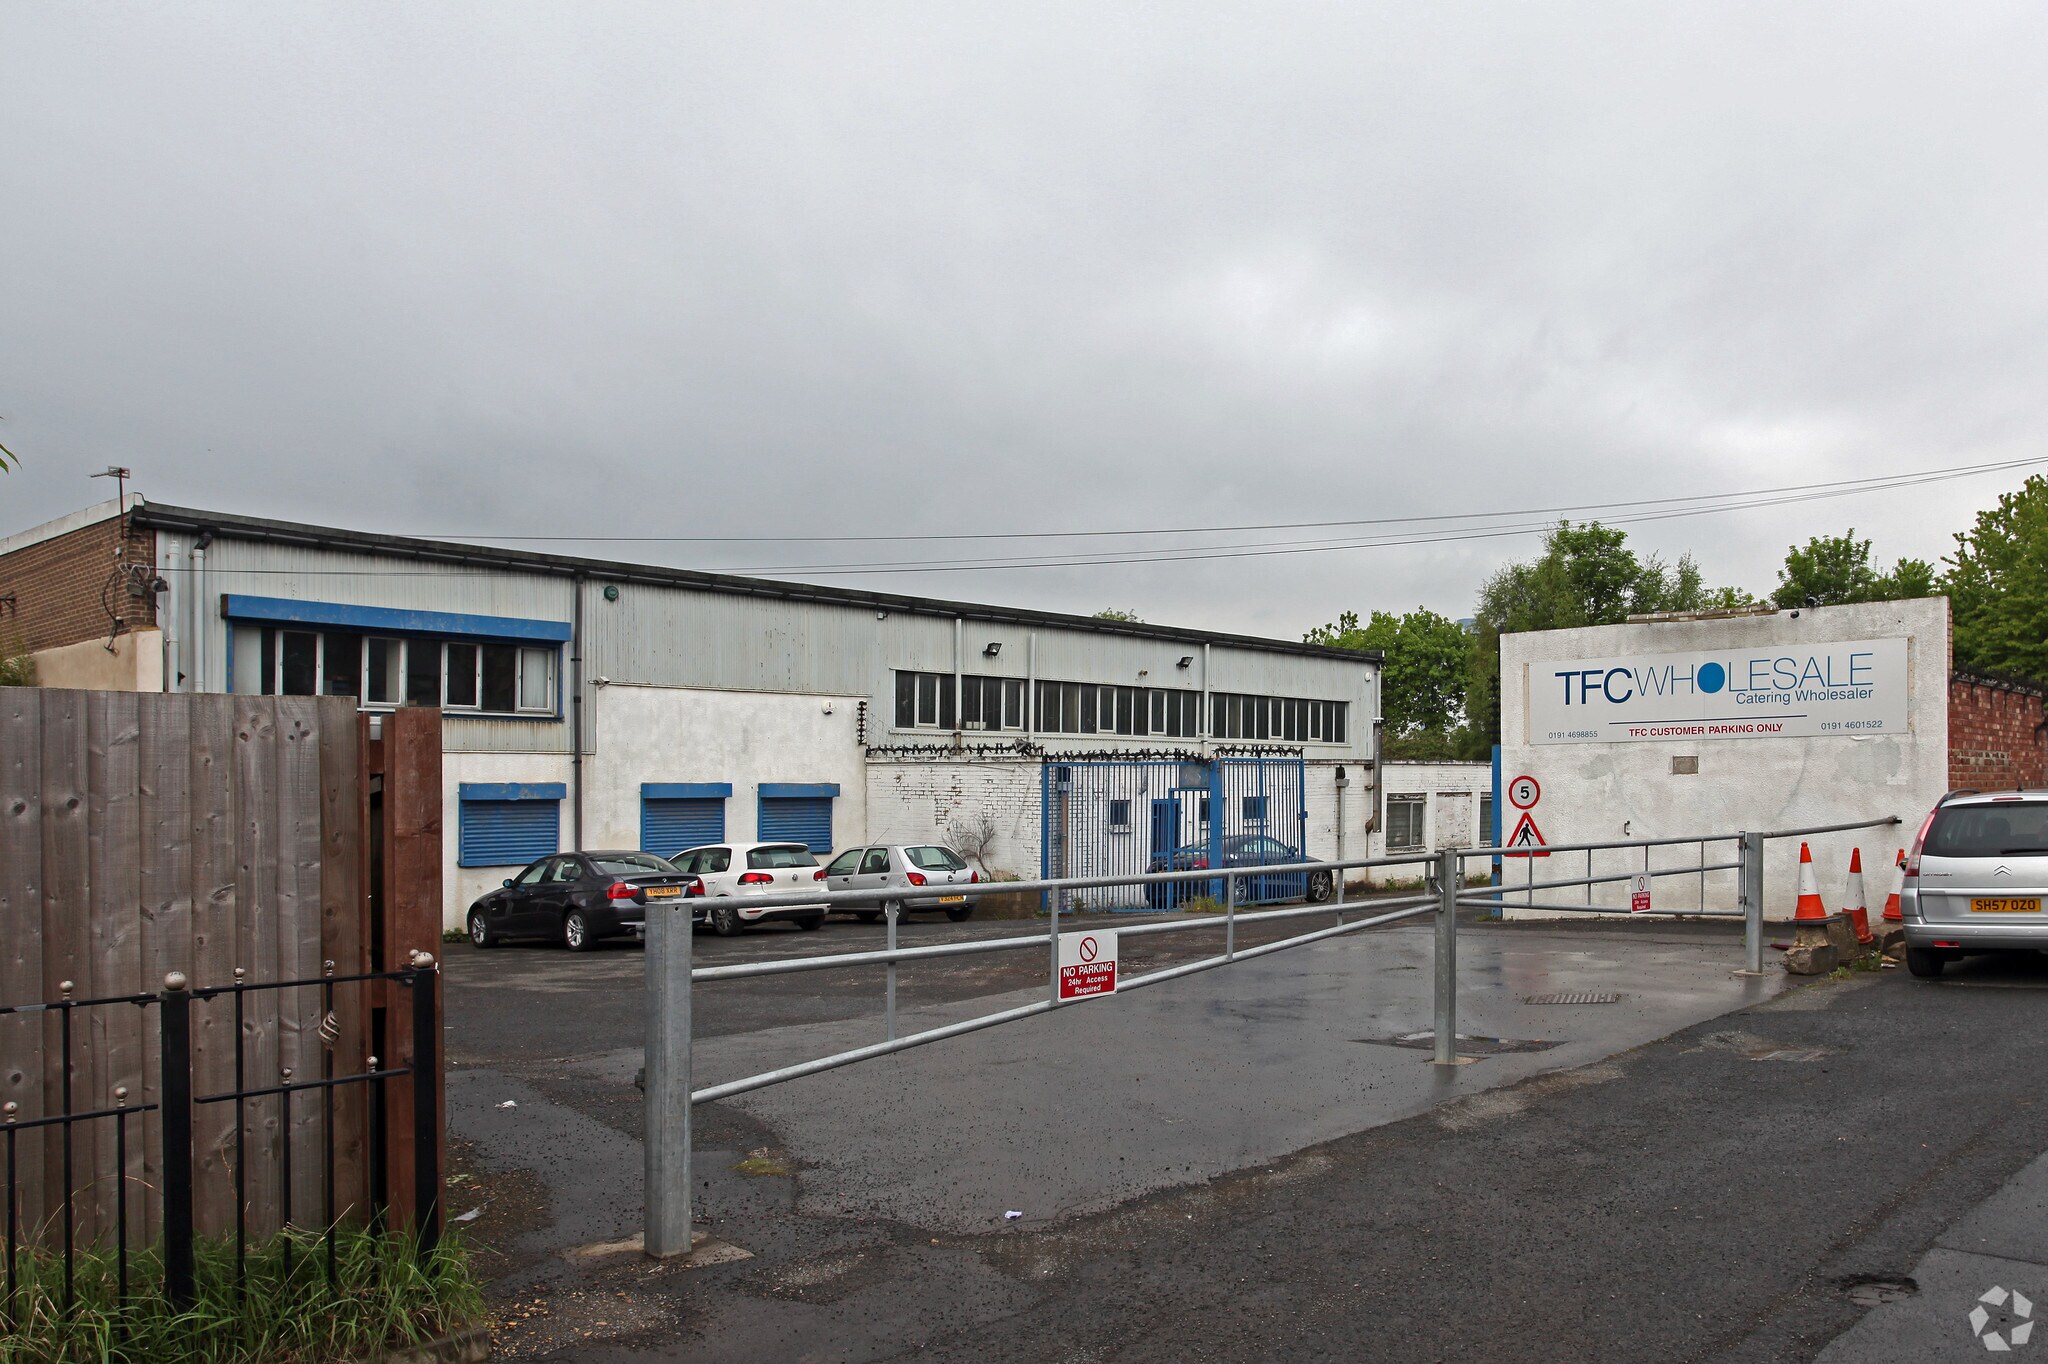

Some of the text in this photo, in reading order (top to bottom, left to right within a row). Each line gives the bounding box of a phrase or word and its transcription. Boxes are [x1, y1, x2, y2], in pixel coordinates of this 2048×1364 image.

[1736, 688, 1874, 706] Catering Wholesaler
[1629, 723, 1783, 737] TFC CUSTOMER PARKING ONLY
[1820, 720, 1883, 730] 0191 4601522
[1520, 786, 1530, 799] 5
[1975, 900, 2007, 911] SH57
[1064, 962, 1112, 978] NO PARKING
[1068, 976, 1108, 986] 24hr Access
[1074, 984, 1101, 994] Required
